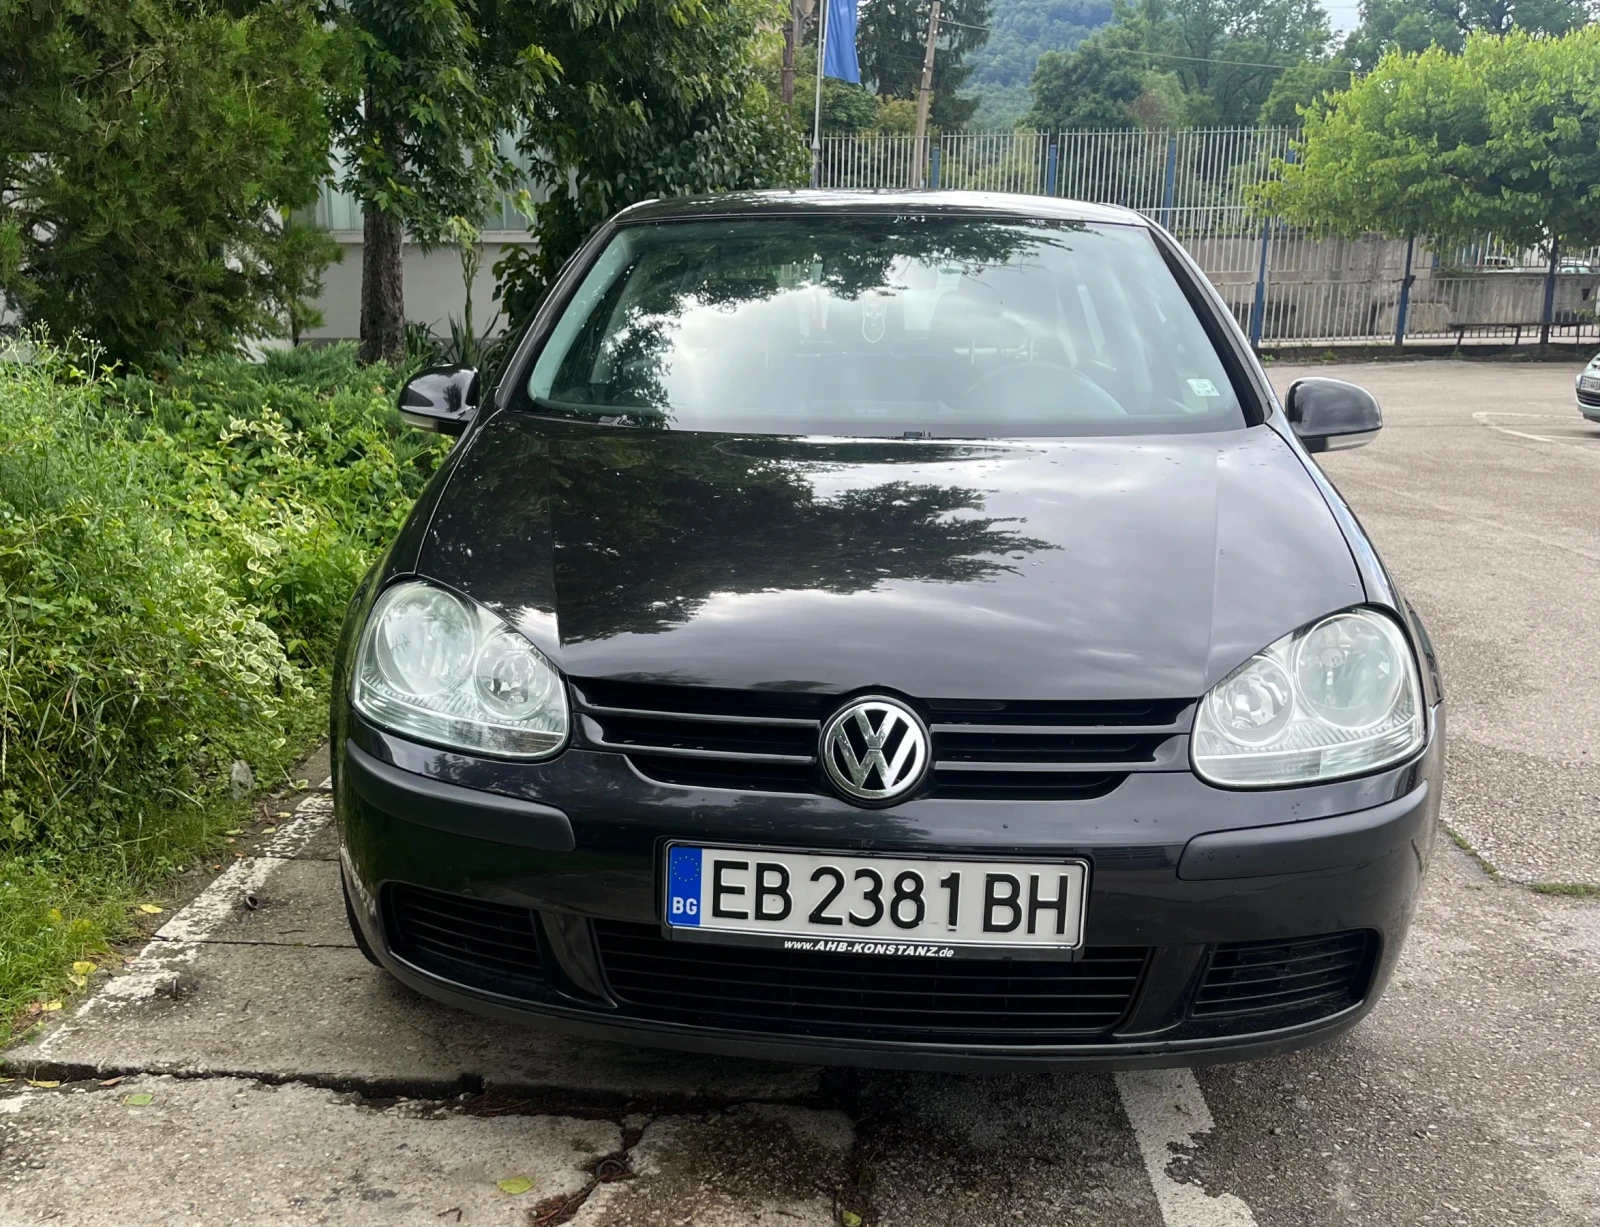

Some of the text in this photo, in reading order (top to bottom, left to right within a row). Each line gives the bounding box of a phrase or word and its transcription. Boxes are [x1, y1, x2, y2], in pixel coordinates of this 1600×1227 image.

[672, 897, 698, 915] BG
[712, 859, 1069, 935] EB 2381 BH
[784, 940, 954, 958] www.AHB-KONSTANZ.de
